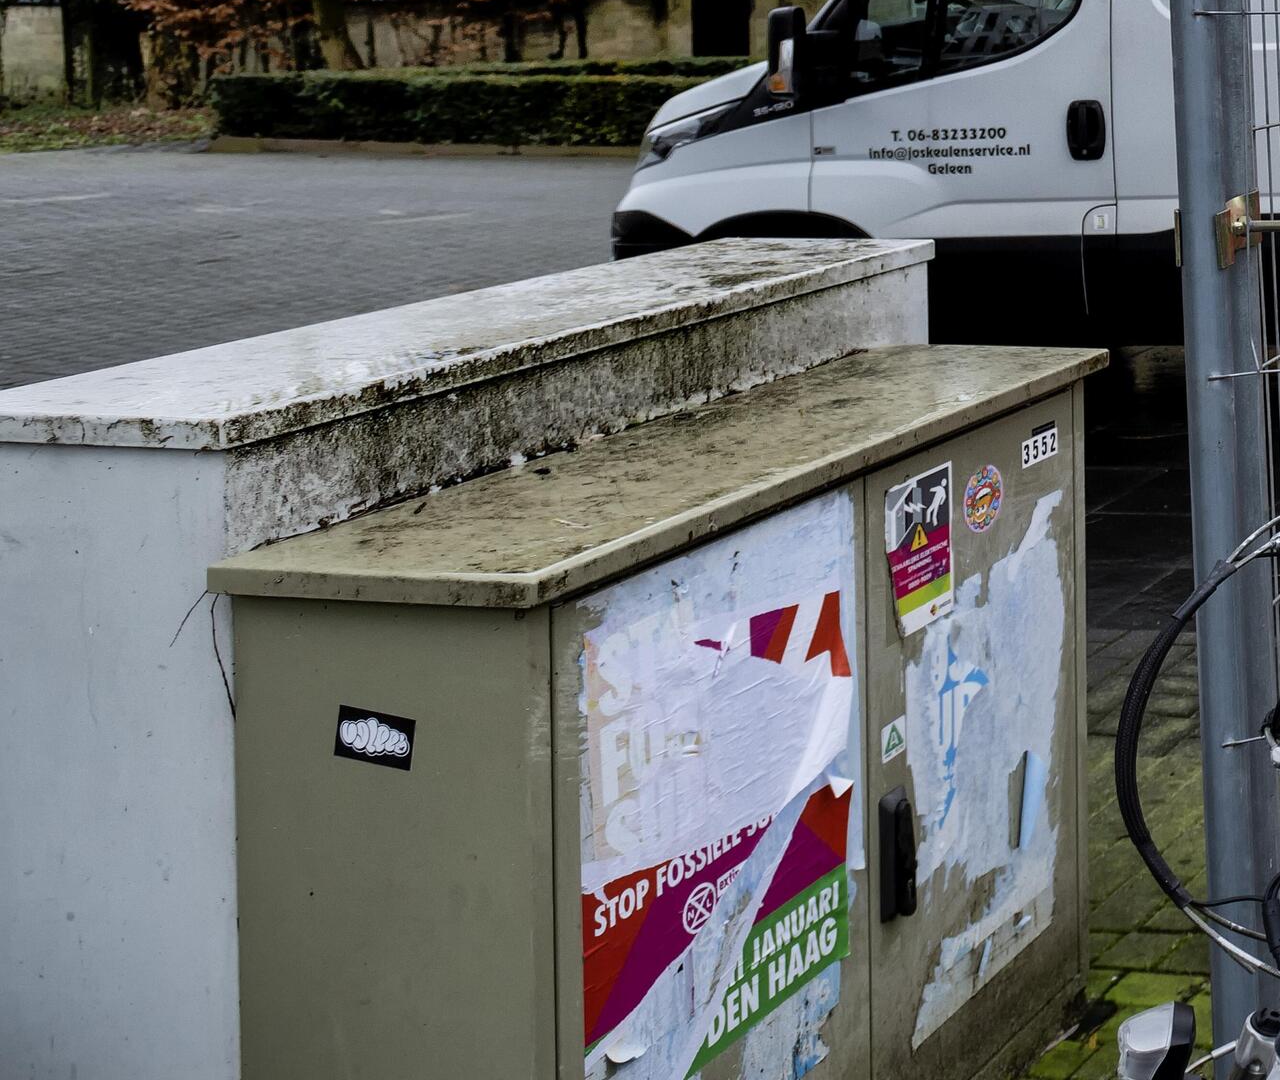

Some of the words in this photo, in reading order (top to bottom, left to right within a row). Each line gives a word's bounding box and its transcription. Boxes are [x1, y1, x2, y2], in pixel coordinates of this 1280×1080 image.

[891, 130, 902, 142] T.
[907, 128, 1006, 142] 06-83233200
[869, 144, 1031, 160] info@joskeulenservice.nl
[928, 163, 972, 175] Geleen
[1023, 432, 1056, 465] 3552
[594, 879, 649, 936] STOP
[751, 881, 839, 970] JANUARI
[708, 972, 760, 1048] DEN
[768, 917, 838, 1000] HAAG
